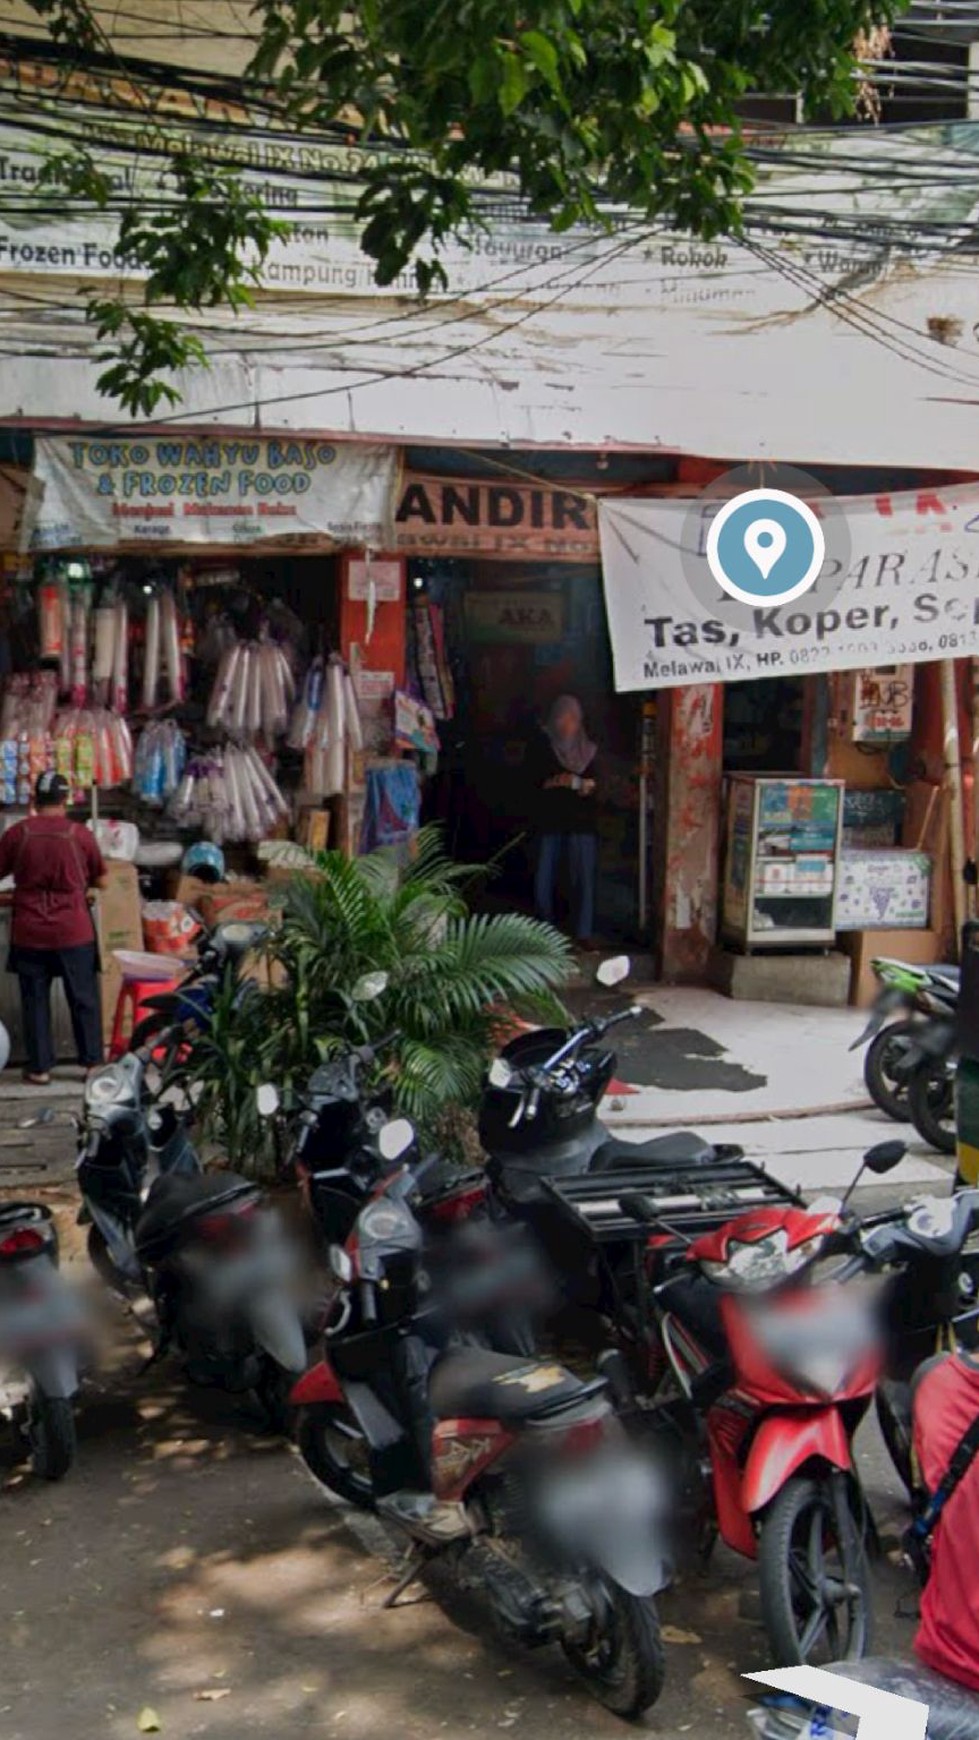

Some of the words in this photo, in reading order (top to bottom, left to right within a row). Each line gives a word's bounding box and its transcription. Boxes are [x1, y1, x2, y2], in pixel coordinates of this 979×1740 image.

[68, 441, 149, 468] TOKO
[155, 441, 260, 467] WAHYU
[267, 440, 336, 470] BASO
[97, 473, 116, 497] &
[122, 470, 231, 498] FROZEN
[237, 470, 312, 497] FOOD
[395, 483, 591, 529] ANDIR
[644, 616, 740, 648] Tas,
[753, 604, 899, 640] Koper,
[757, 651, 784, 667] HP.
